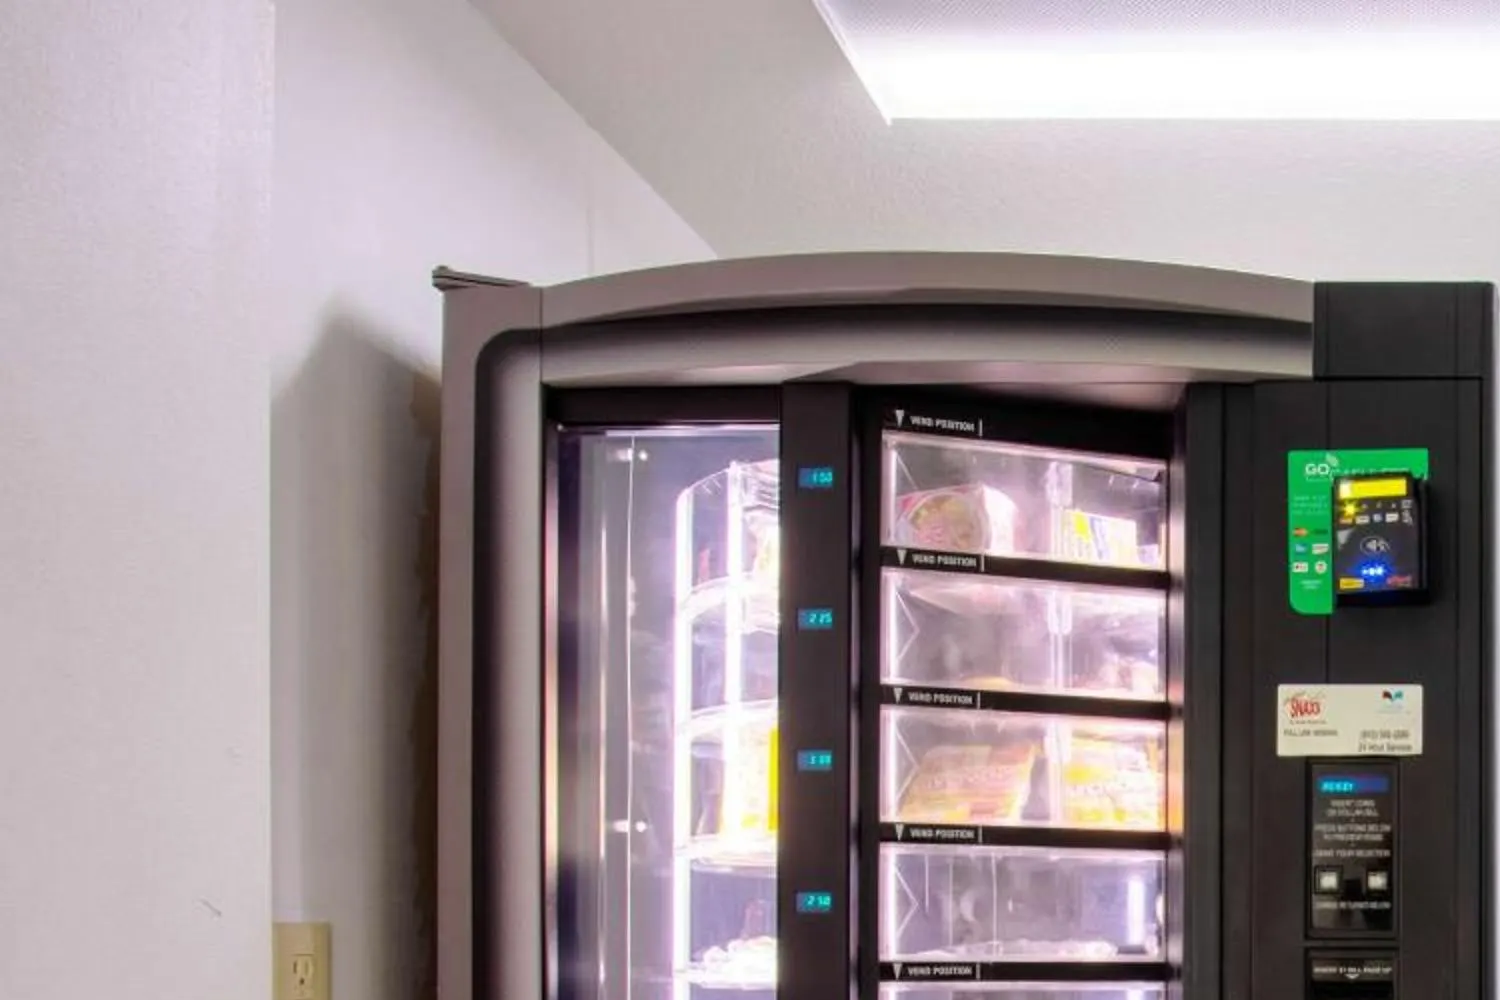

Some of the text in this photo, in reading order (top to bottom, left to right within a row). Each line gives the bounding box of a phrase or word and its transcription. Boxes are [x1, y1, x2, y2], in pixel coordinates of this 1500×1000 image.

[909, 415, 975, 432] VEND POSITION
[911, 553, 977, 568] VEND POSITION
[908, 692, 973, 705] VEND POSITION
[909, 828, 974, 839] VEND POSITION
[908, 966, 972, 976] VEND POSITION
